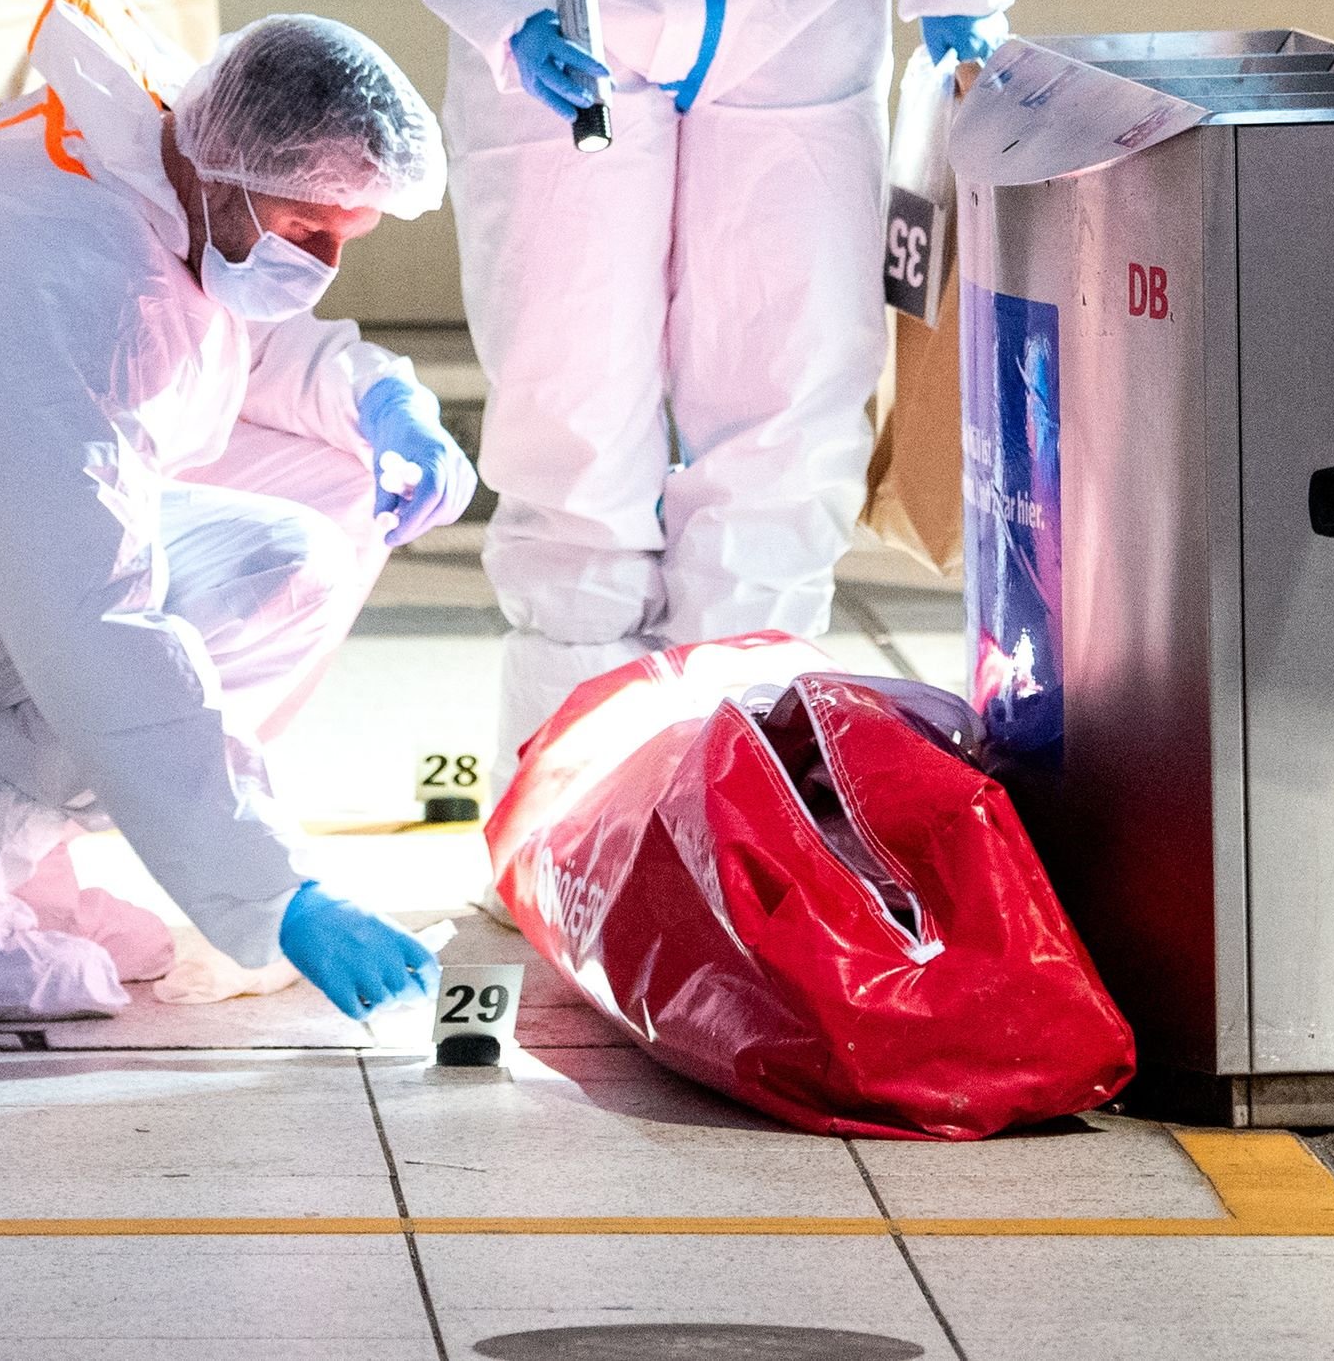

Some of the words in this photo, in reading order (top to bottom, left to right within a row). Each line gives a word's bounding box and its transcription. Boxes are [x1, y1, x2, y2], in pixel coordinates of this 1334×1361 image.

[1129, 262, 1168, 320] DB
[1017, 489, 1045, 531] hier.
[423, 754, 477, 787] 28
[440, 984, 509, 1024] 29
